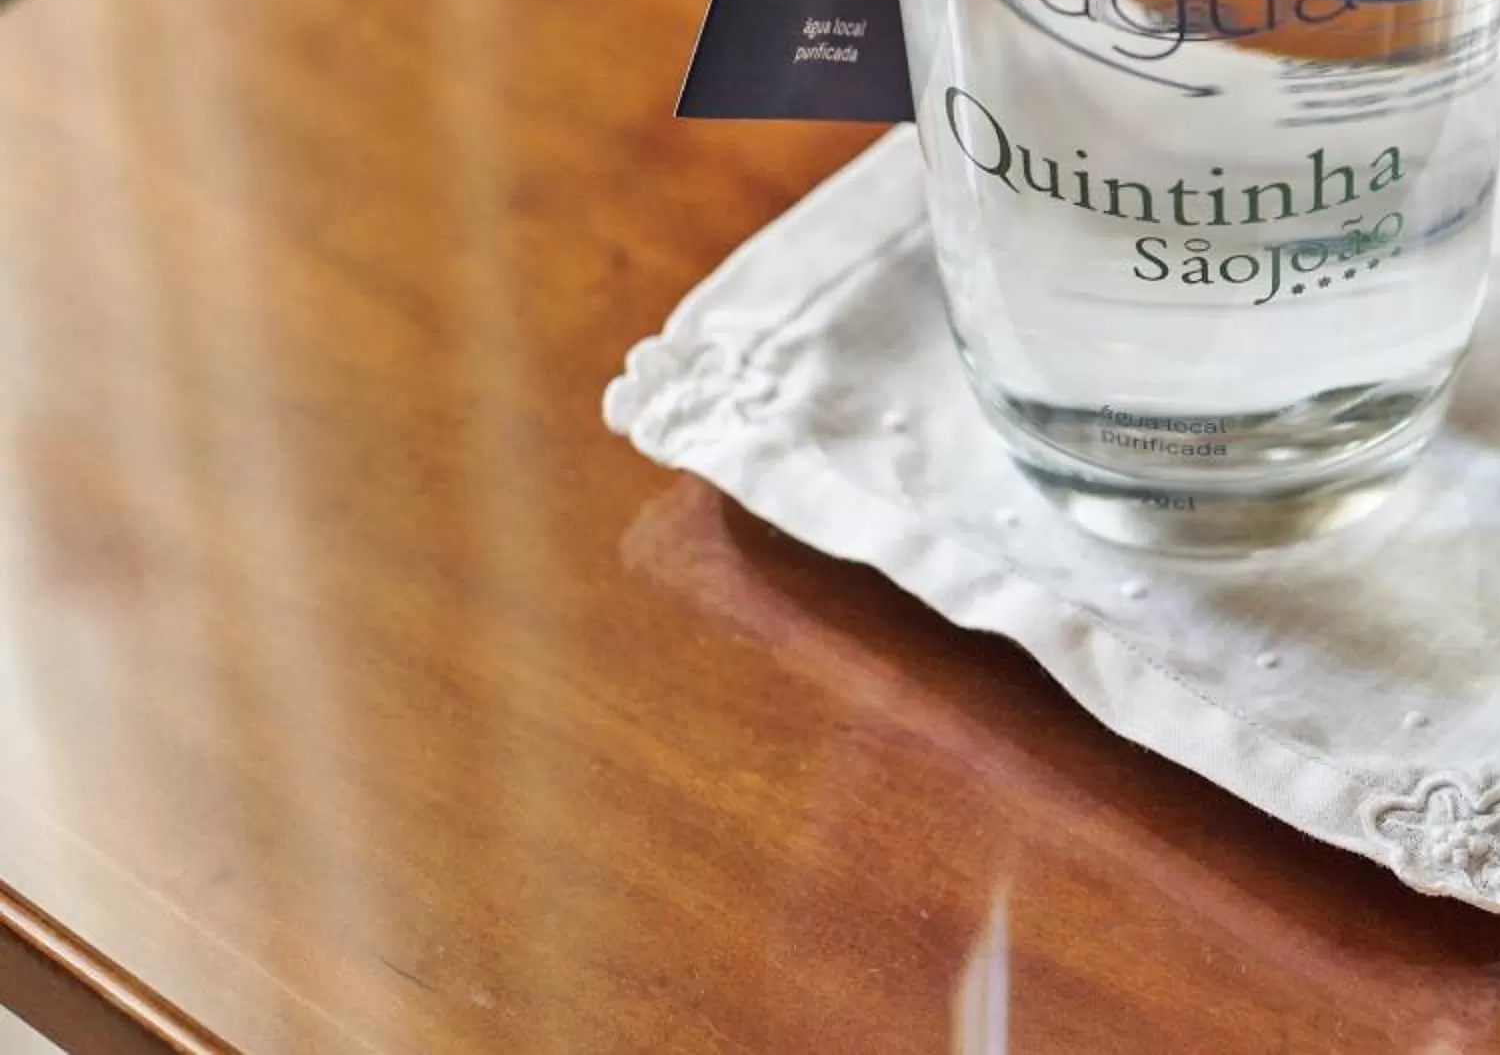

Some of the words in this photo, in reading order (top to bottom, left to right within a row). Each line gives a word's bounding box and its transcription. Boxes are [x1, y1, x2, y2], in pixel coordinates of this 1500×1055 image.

[833, 17, 867, 37] local
[793, 42, 859, 63] purificada
[945, 86, 1407, 227] Quintinha
